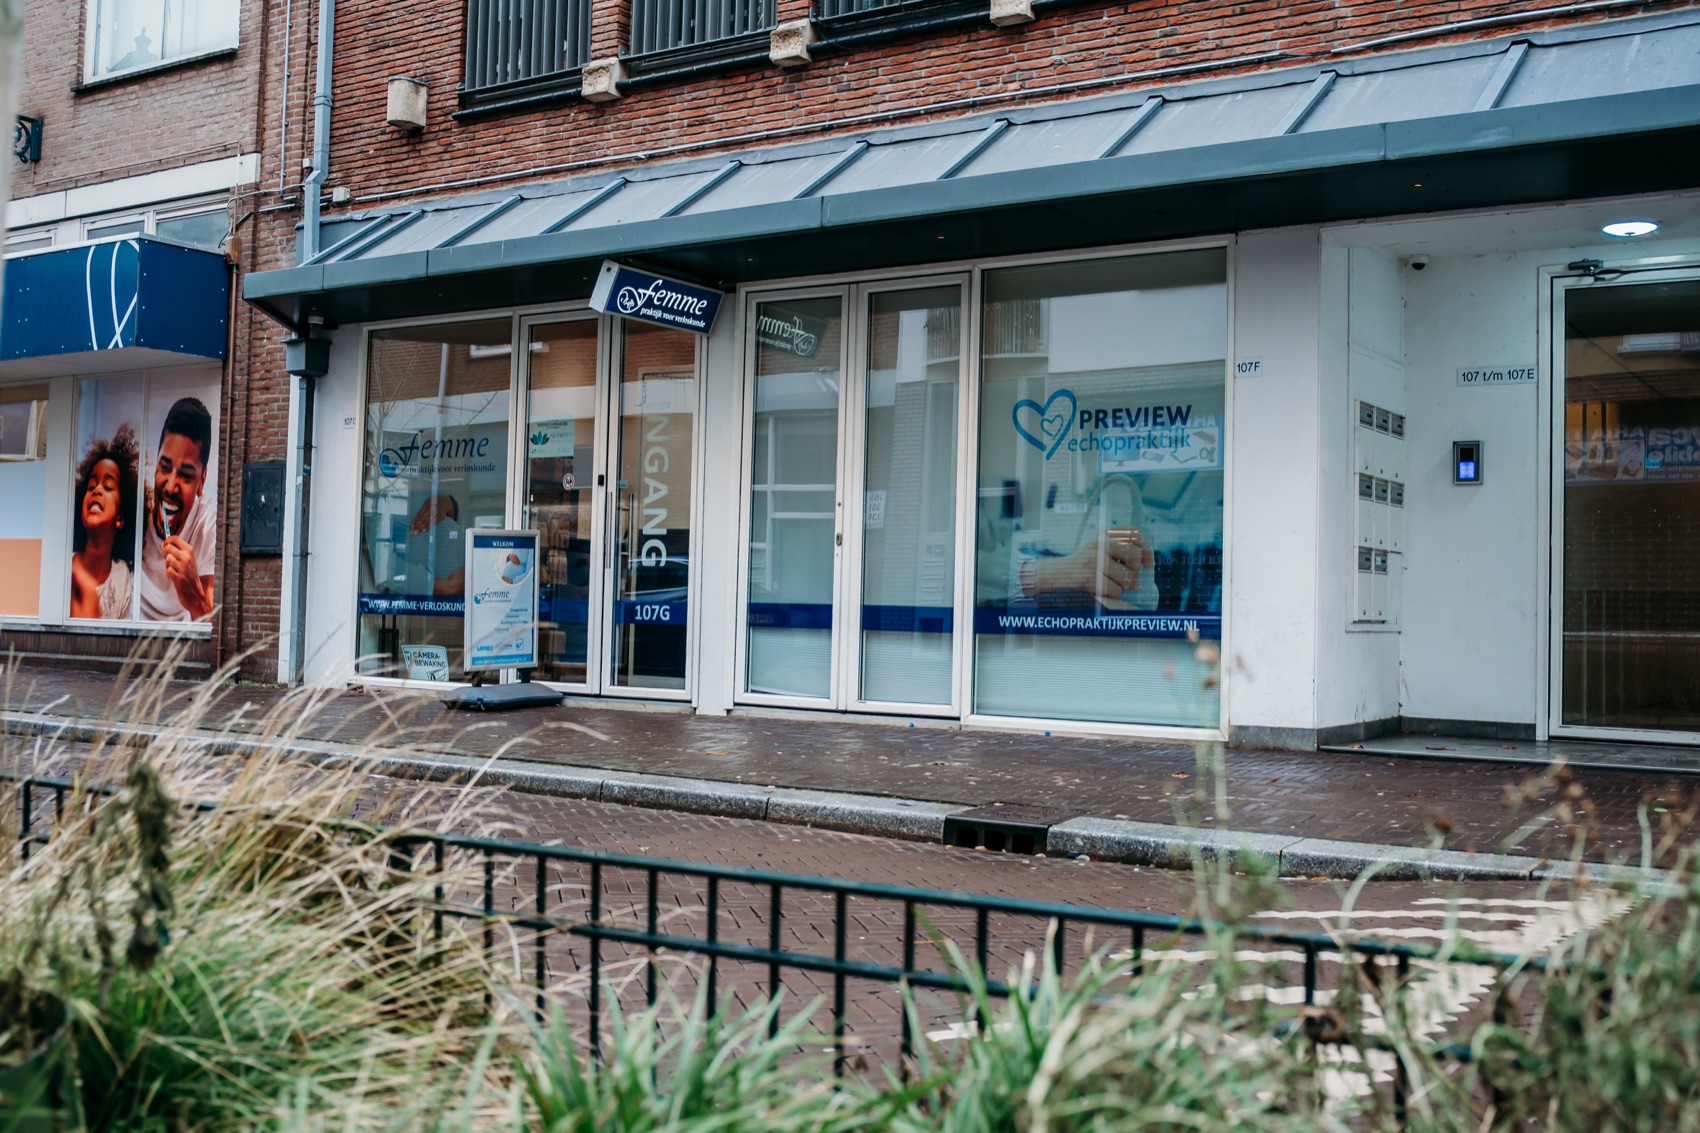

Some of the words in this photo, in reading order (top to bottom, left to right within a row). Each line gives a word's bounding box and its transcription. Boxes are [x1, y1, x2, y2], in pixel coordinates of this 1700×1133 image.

[637, 279, 708, 315] femme
[640, 307, 662, 319] praktijk
[663, 312, 675, 320] voor
[675, 314, 706, 328] verloskunde
[1237, 361, 1260, 373] 107F
[1461, 371, 1480, 382] 107
[1483, 370, 1503, 381] t/m
[1079, 405, 1192, 430] PREVIEW
[399, 429, 490, 466] femme
[1068, 428, 1191, 455] echopraktijk
[453, 463, 496, 473] verloskunde
[480, 588, 510, 600] femme
[635, 605, 670, 621] 107G
[999, 615, 1200, 632] WWW.ECHOPRAKTIJKPREVIEW.NL
[415, 659, 446, 668] BEWAKING
